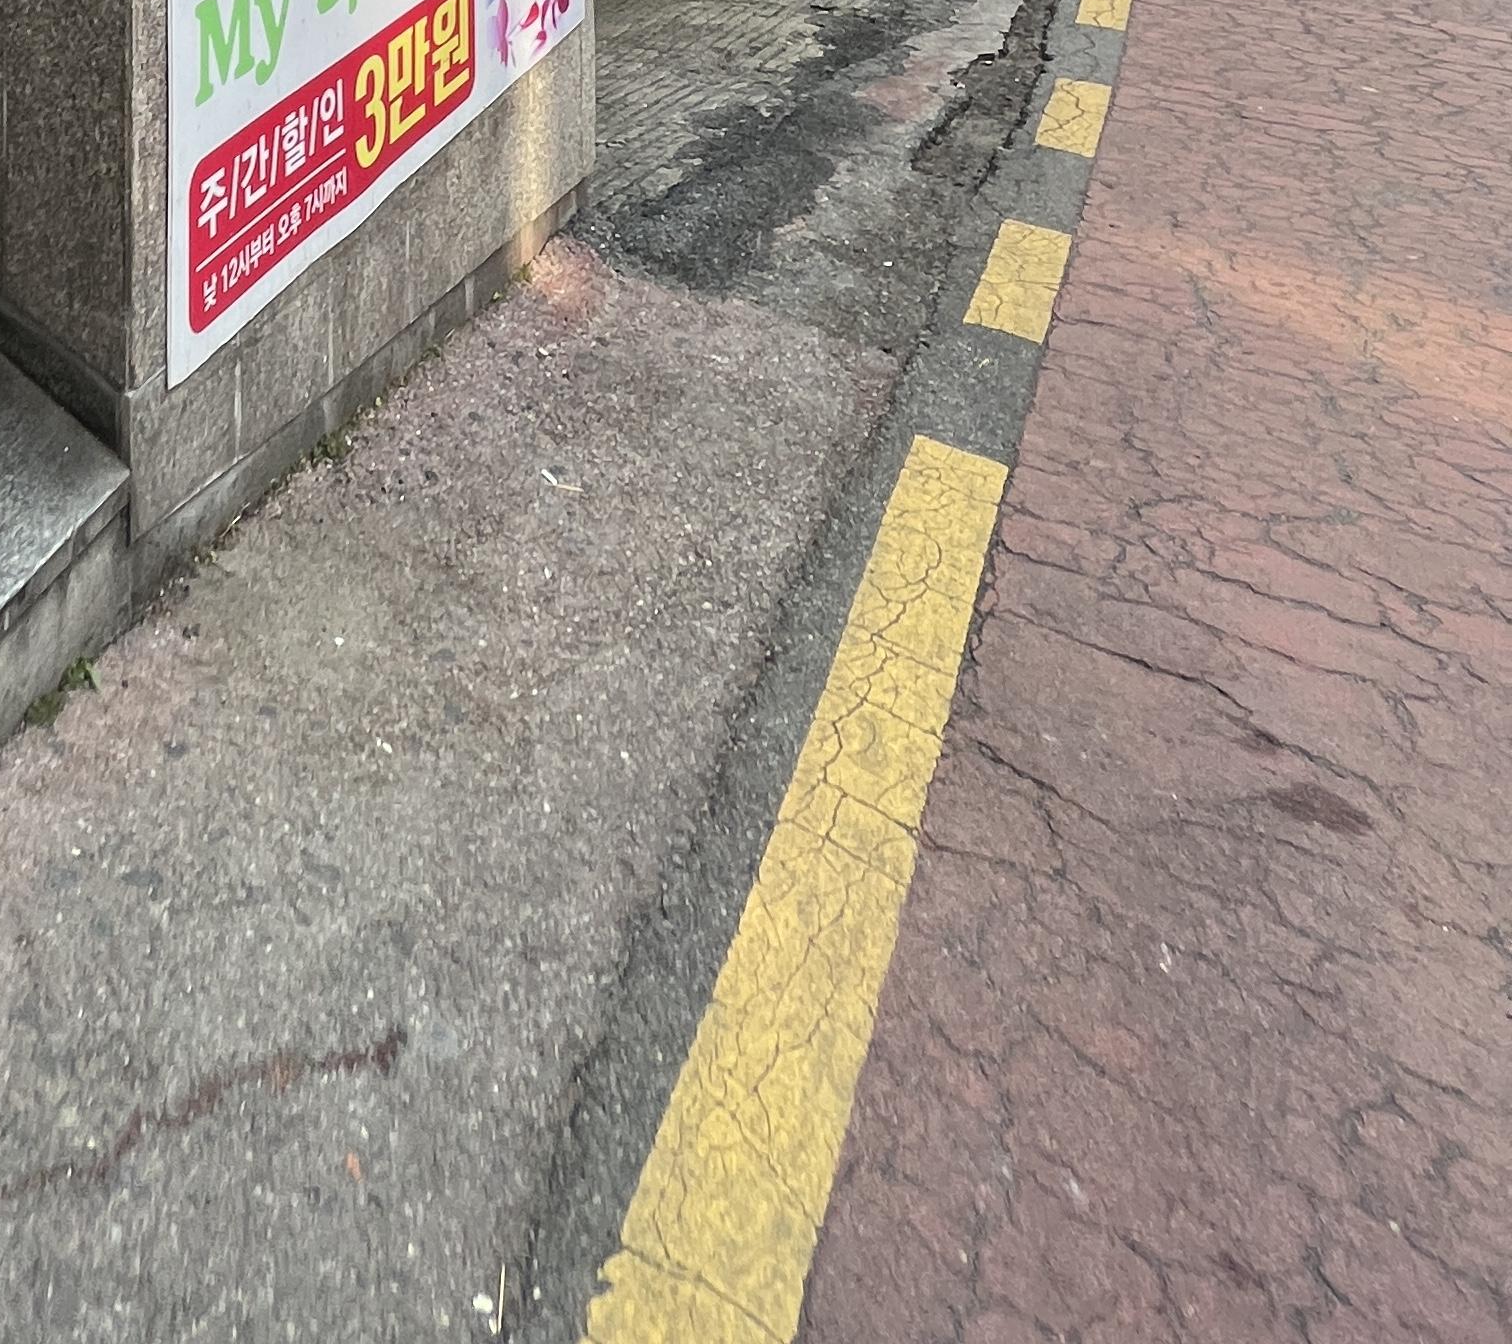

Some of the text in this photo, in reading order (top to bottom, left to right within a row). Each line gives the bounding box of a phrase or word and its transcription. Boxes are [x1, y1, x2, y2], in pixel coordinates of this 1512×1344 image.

[197, 78, 346, 239] 주/간/할/인
[202, 165, 349, 312] 낮 12시부터 오후 7시까지
